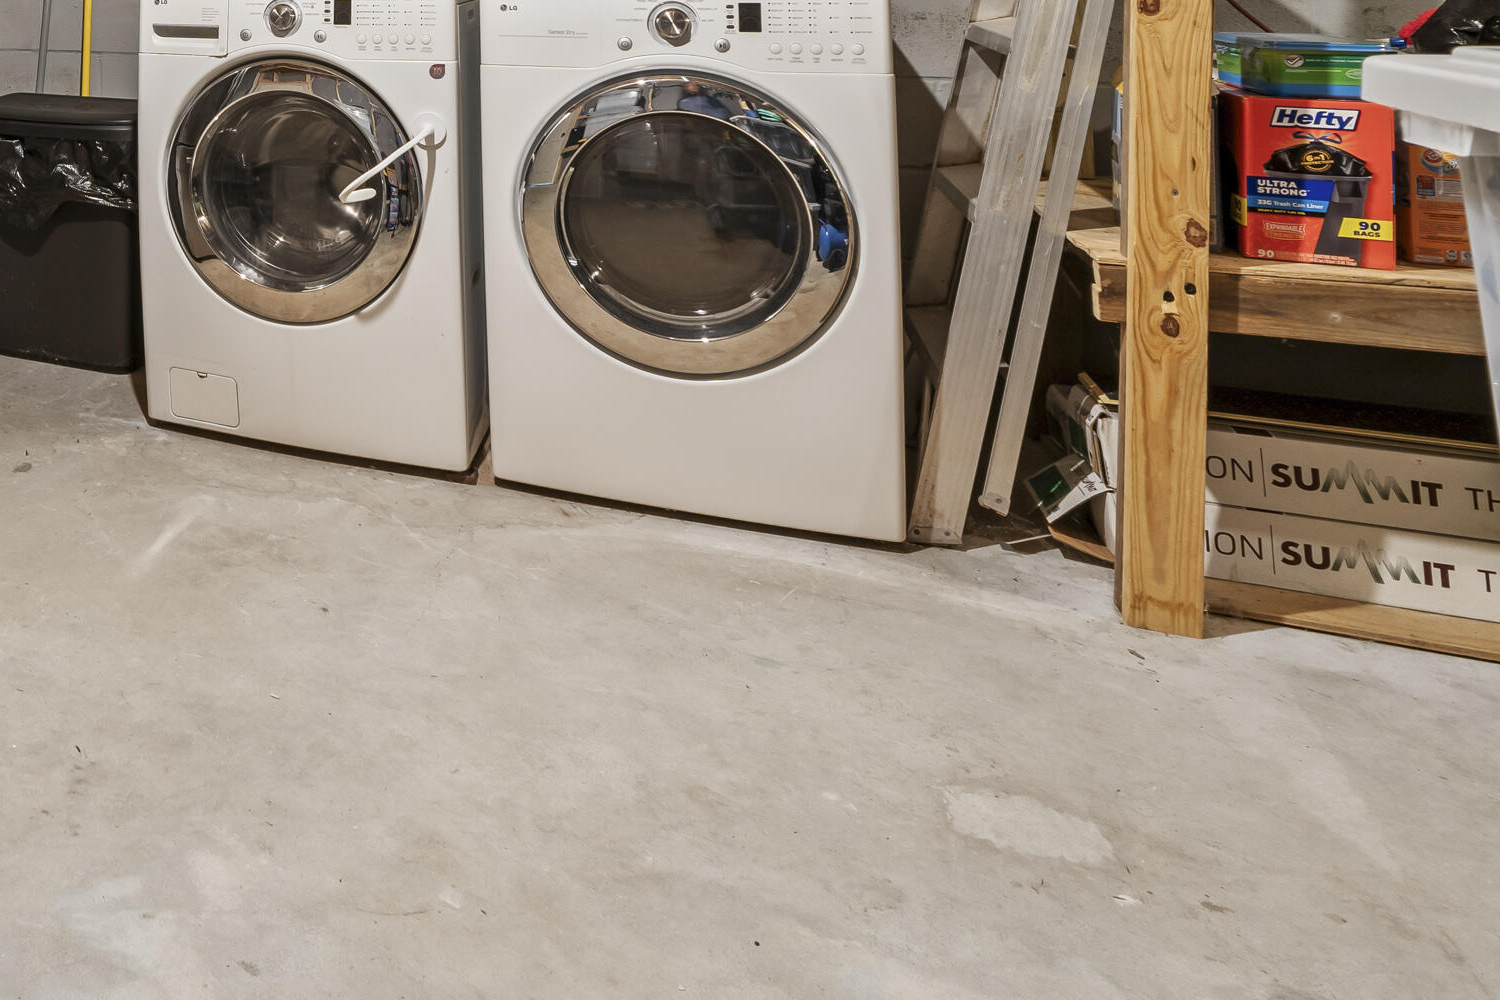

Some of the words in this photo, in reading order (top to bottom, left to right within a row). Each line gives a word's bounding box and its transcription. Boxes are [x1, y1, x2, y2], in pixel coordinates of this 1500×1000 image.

[1276, 108, 1354, 130] Hefty
[1257, 179, 1298, 189] ULTRA
[1257, 187, 1308, 197] STRONG
[1359, 221, 1381, 232] 90
[1353, 230, 1381, 238] BAGS
[1257, 248, 1275, 258] 90
[1270, 458, 1444, 507] SUMMIT
[1280, 537, 1456, 589] SUMMIT
